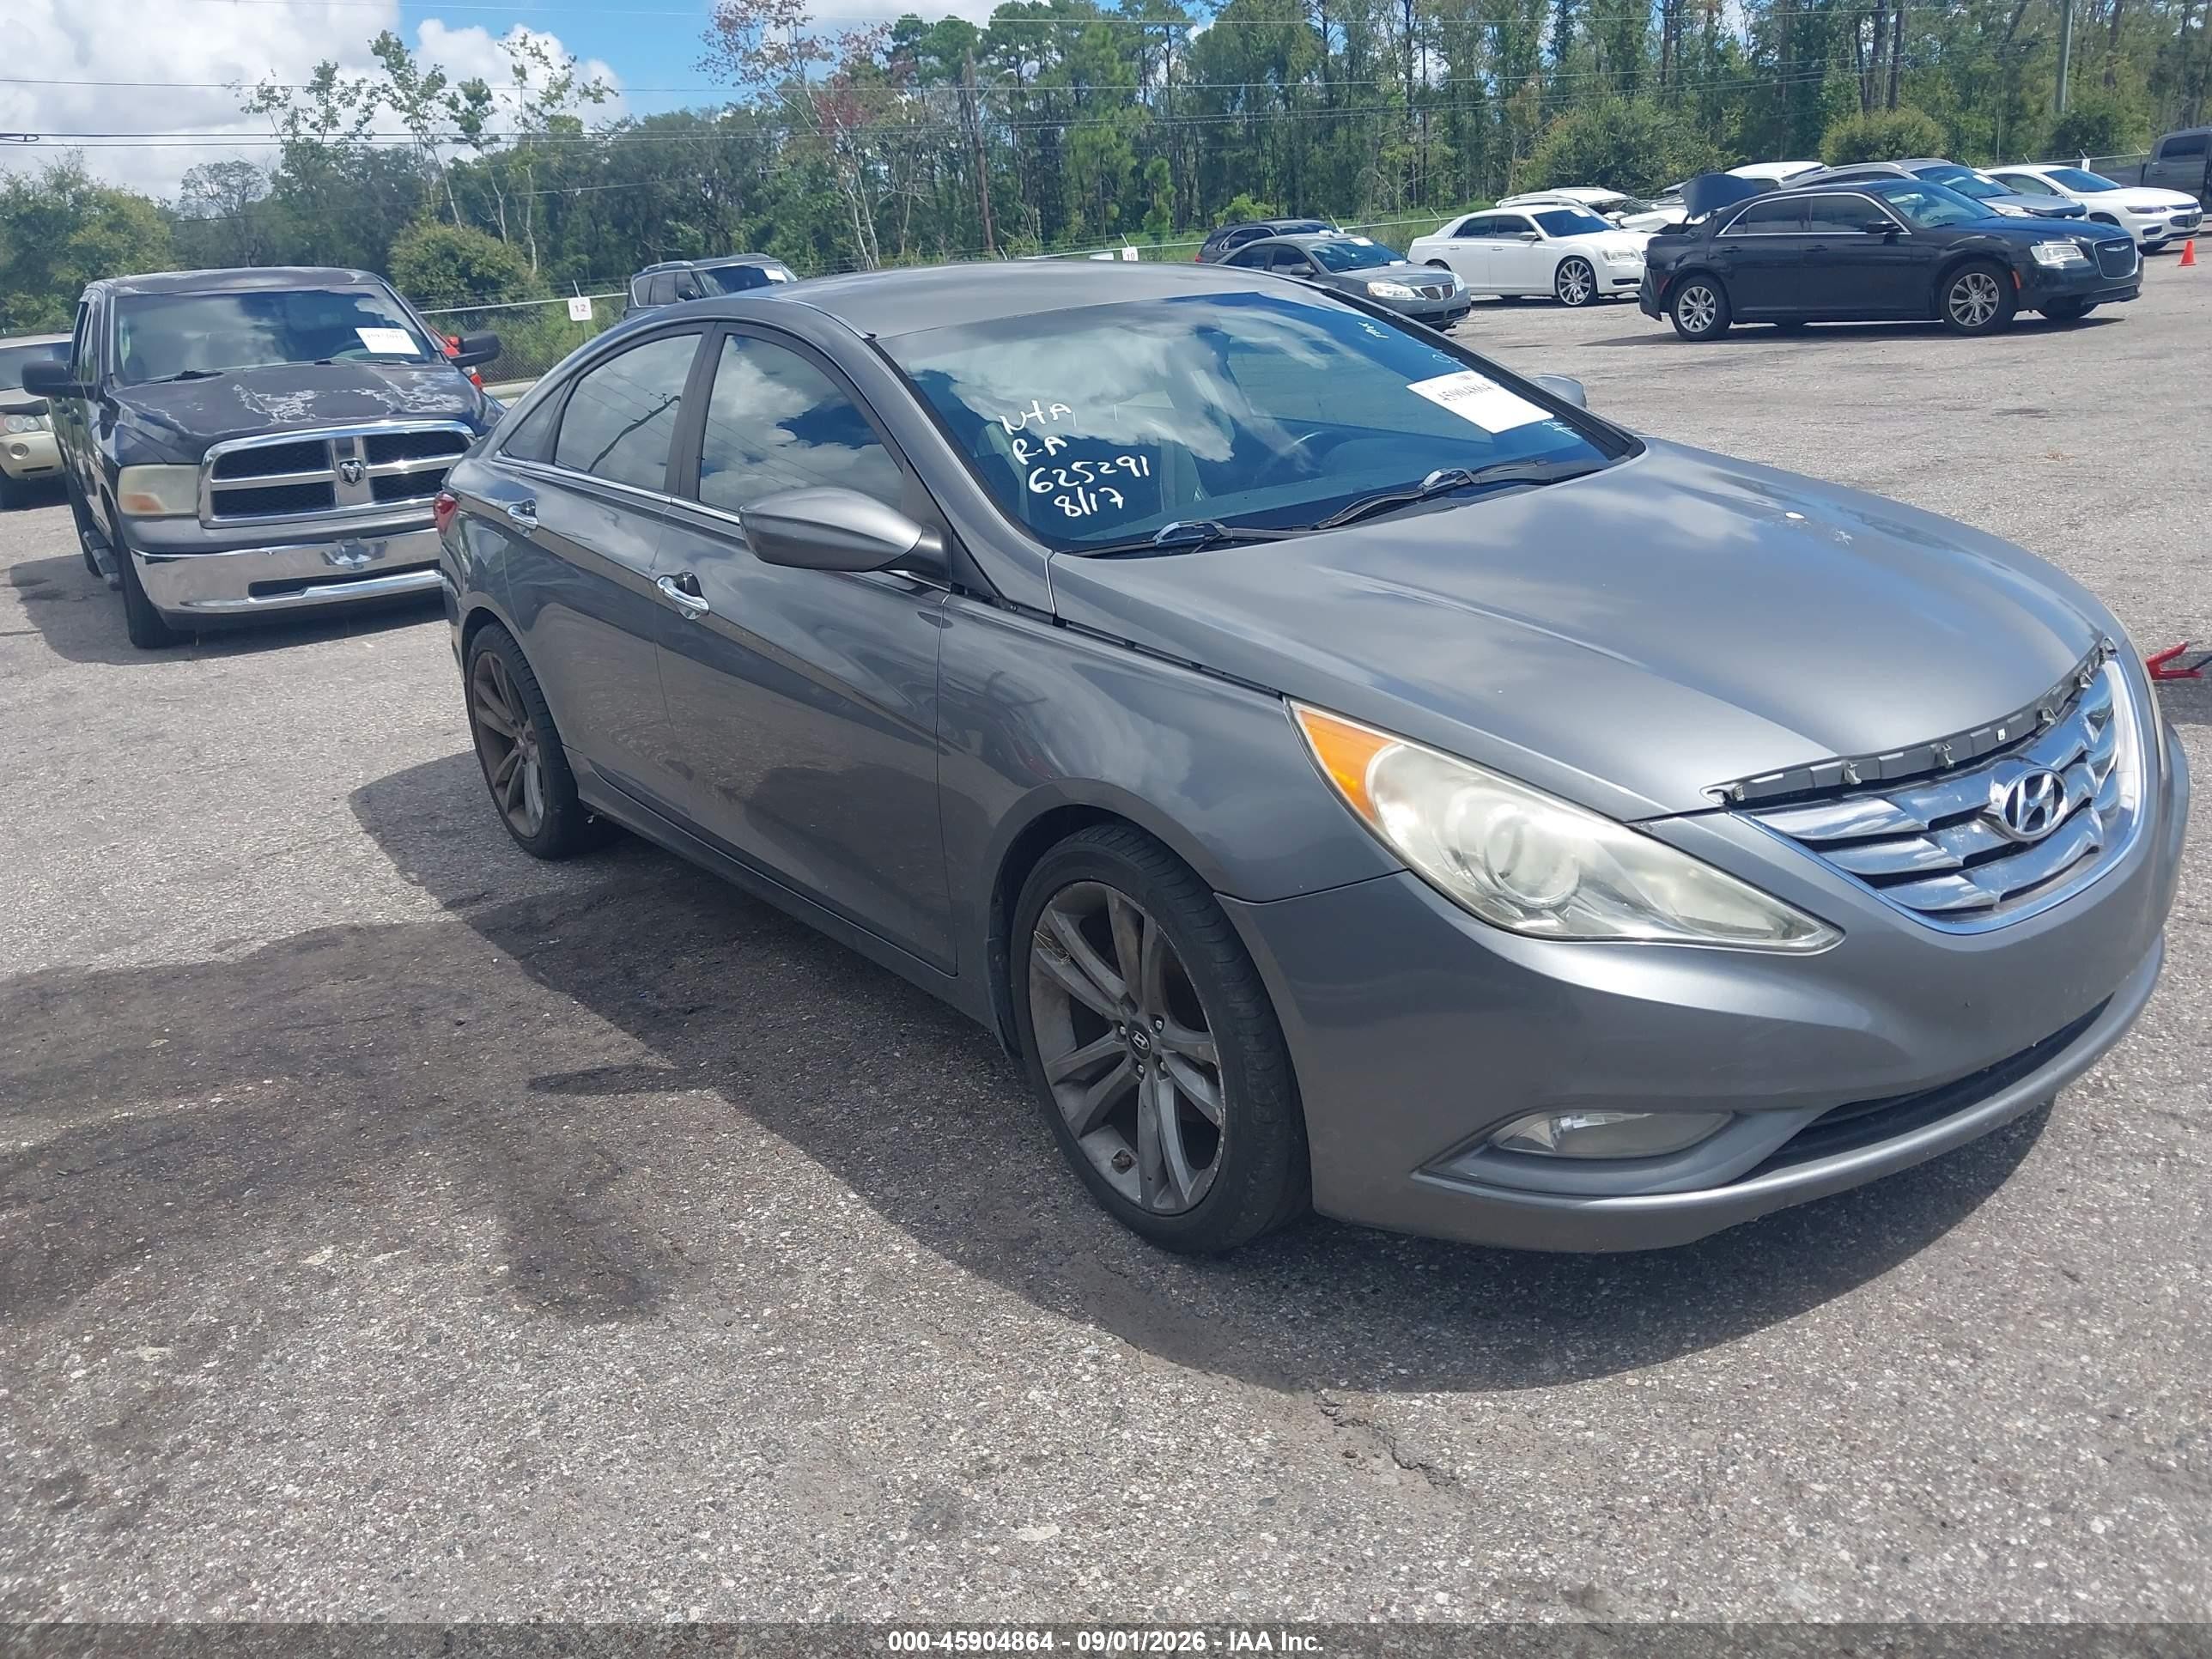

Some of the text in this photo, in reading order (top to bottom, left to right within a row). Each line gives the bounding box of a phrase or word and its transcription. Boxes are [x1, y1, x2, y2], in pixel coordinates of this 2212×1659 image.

[574, 304, 587, 313] 12
[1028, 454, 1151, 494] 625291
[1053, 486, 1125, 518] 8/17
